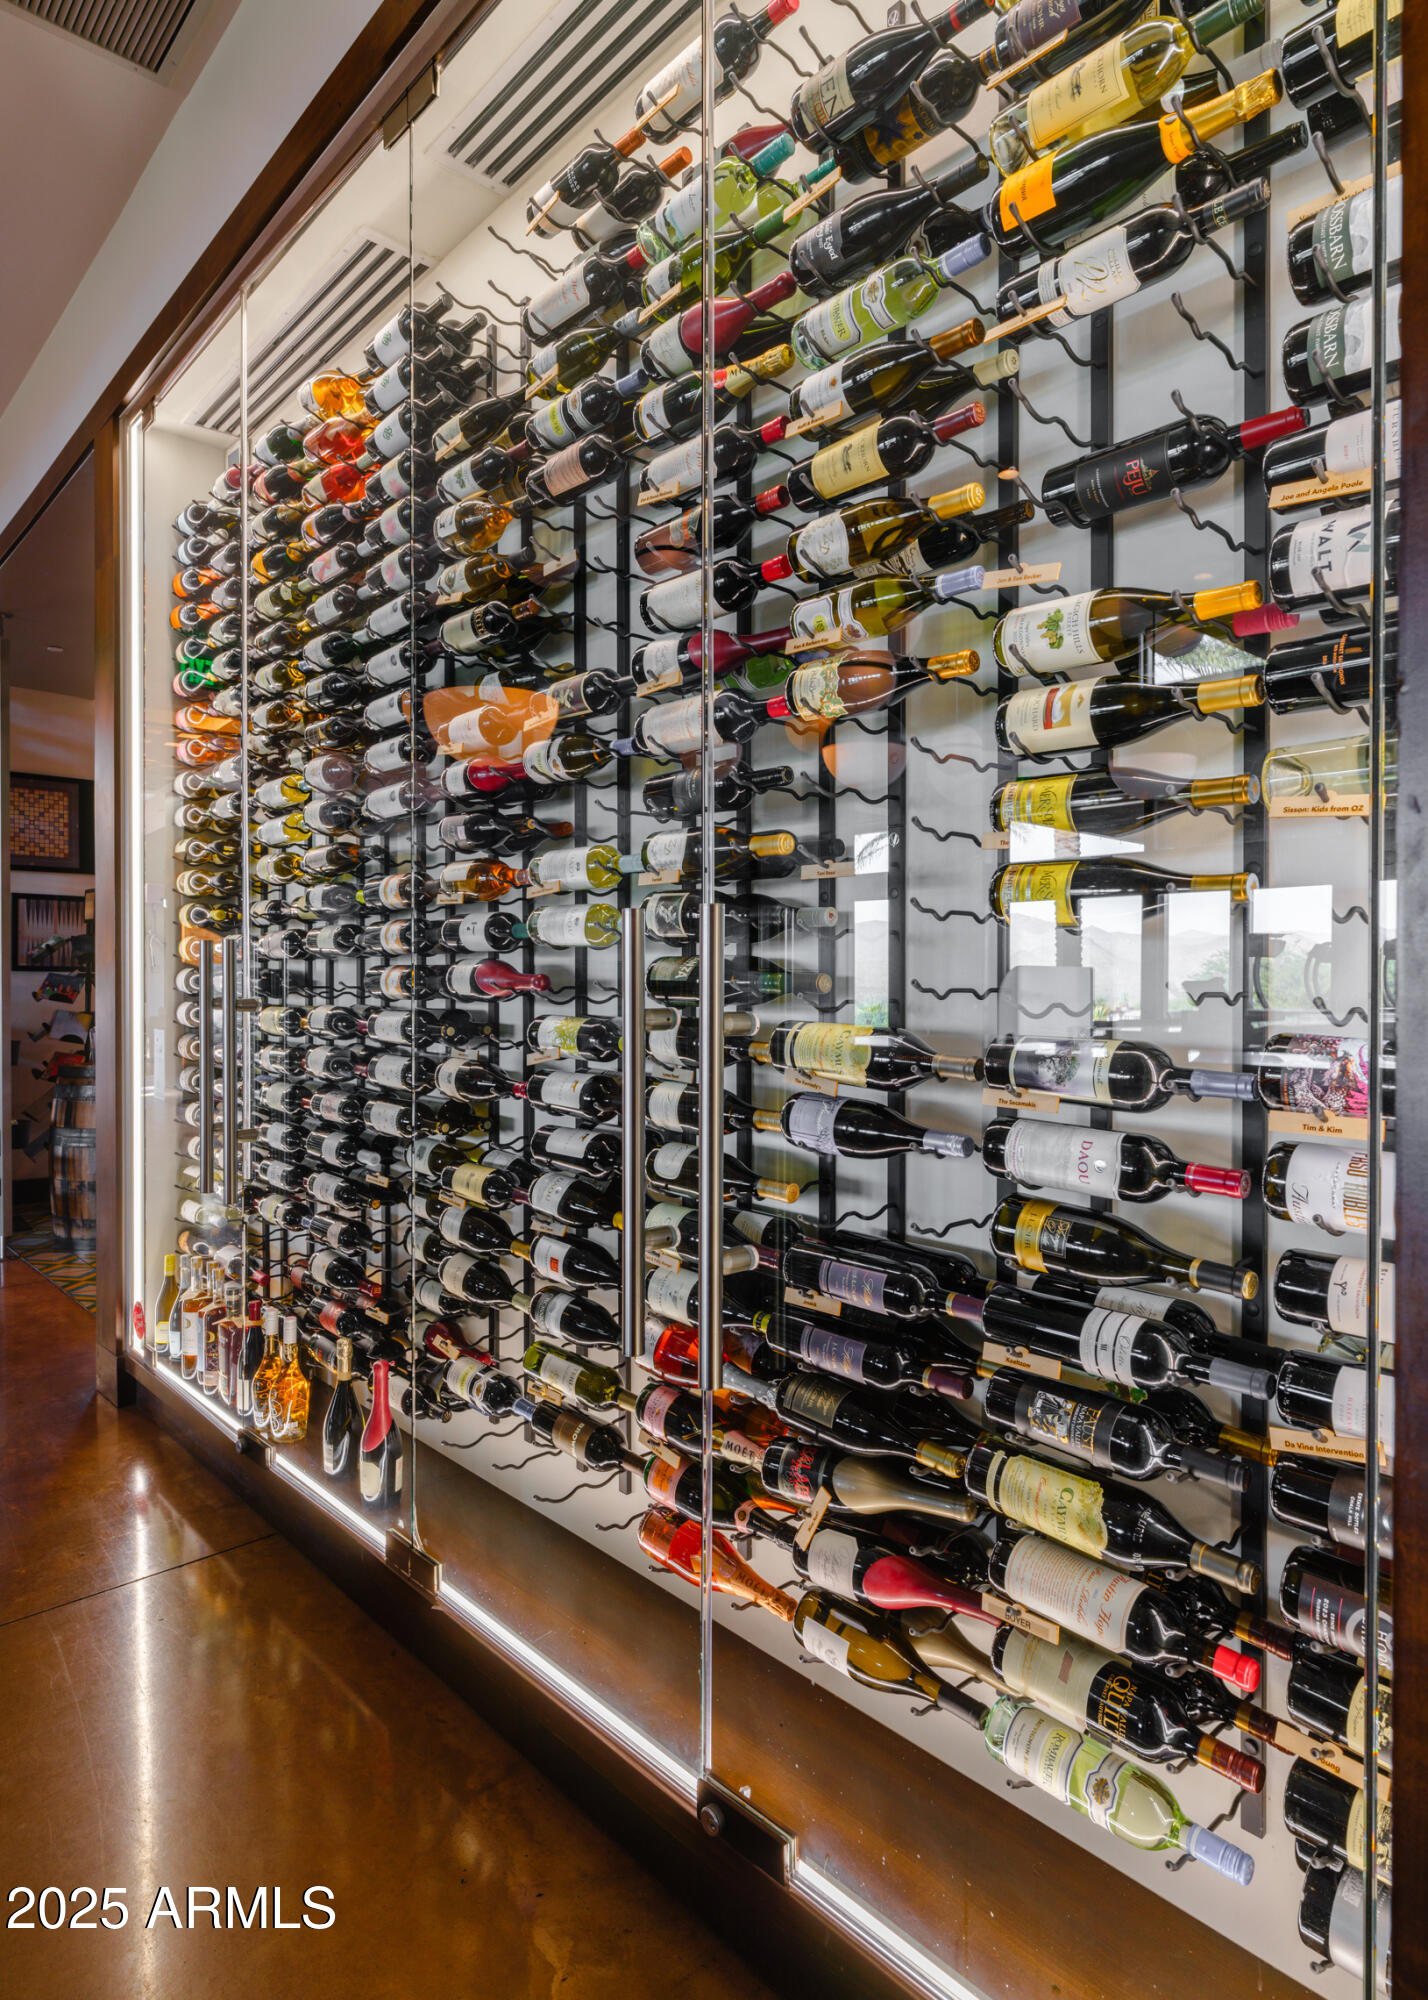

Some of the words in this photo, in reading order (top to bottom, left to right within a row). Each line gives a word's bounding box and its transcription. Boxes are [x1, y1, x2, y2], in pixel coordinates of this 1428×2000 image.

[823, 235, 839, 260] Eyed
[1122, 458, 1147, 496] PEJU
[1280, 494, 1294, 502] Joe
[1310, 485, 1340, 496] Angela
[1340, 479, 1364, 490] Poole
[1317, 519, 1337, 572] WALT
[1073, 632, 1085, 654] HILLS
[1311, 804, 1329, 813] Kids
[1330, 804, 1347, 813] from
[1302, 1123, 1317, 1131] Tim
[1326, 1126, 1343, 1134] Kim
[1077, 1140, 1094, 1185] DAOU
[1081, 1407, 1102, 1453] FAUST
[1296, 1442, 1315, 1452] Vine
[1315, 1445, 1365, 1459] Intervention
[1103, 1573, 1130, 1603] Austin
[1124, 1683, 1139, 1708] NAPA
